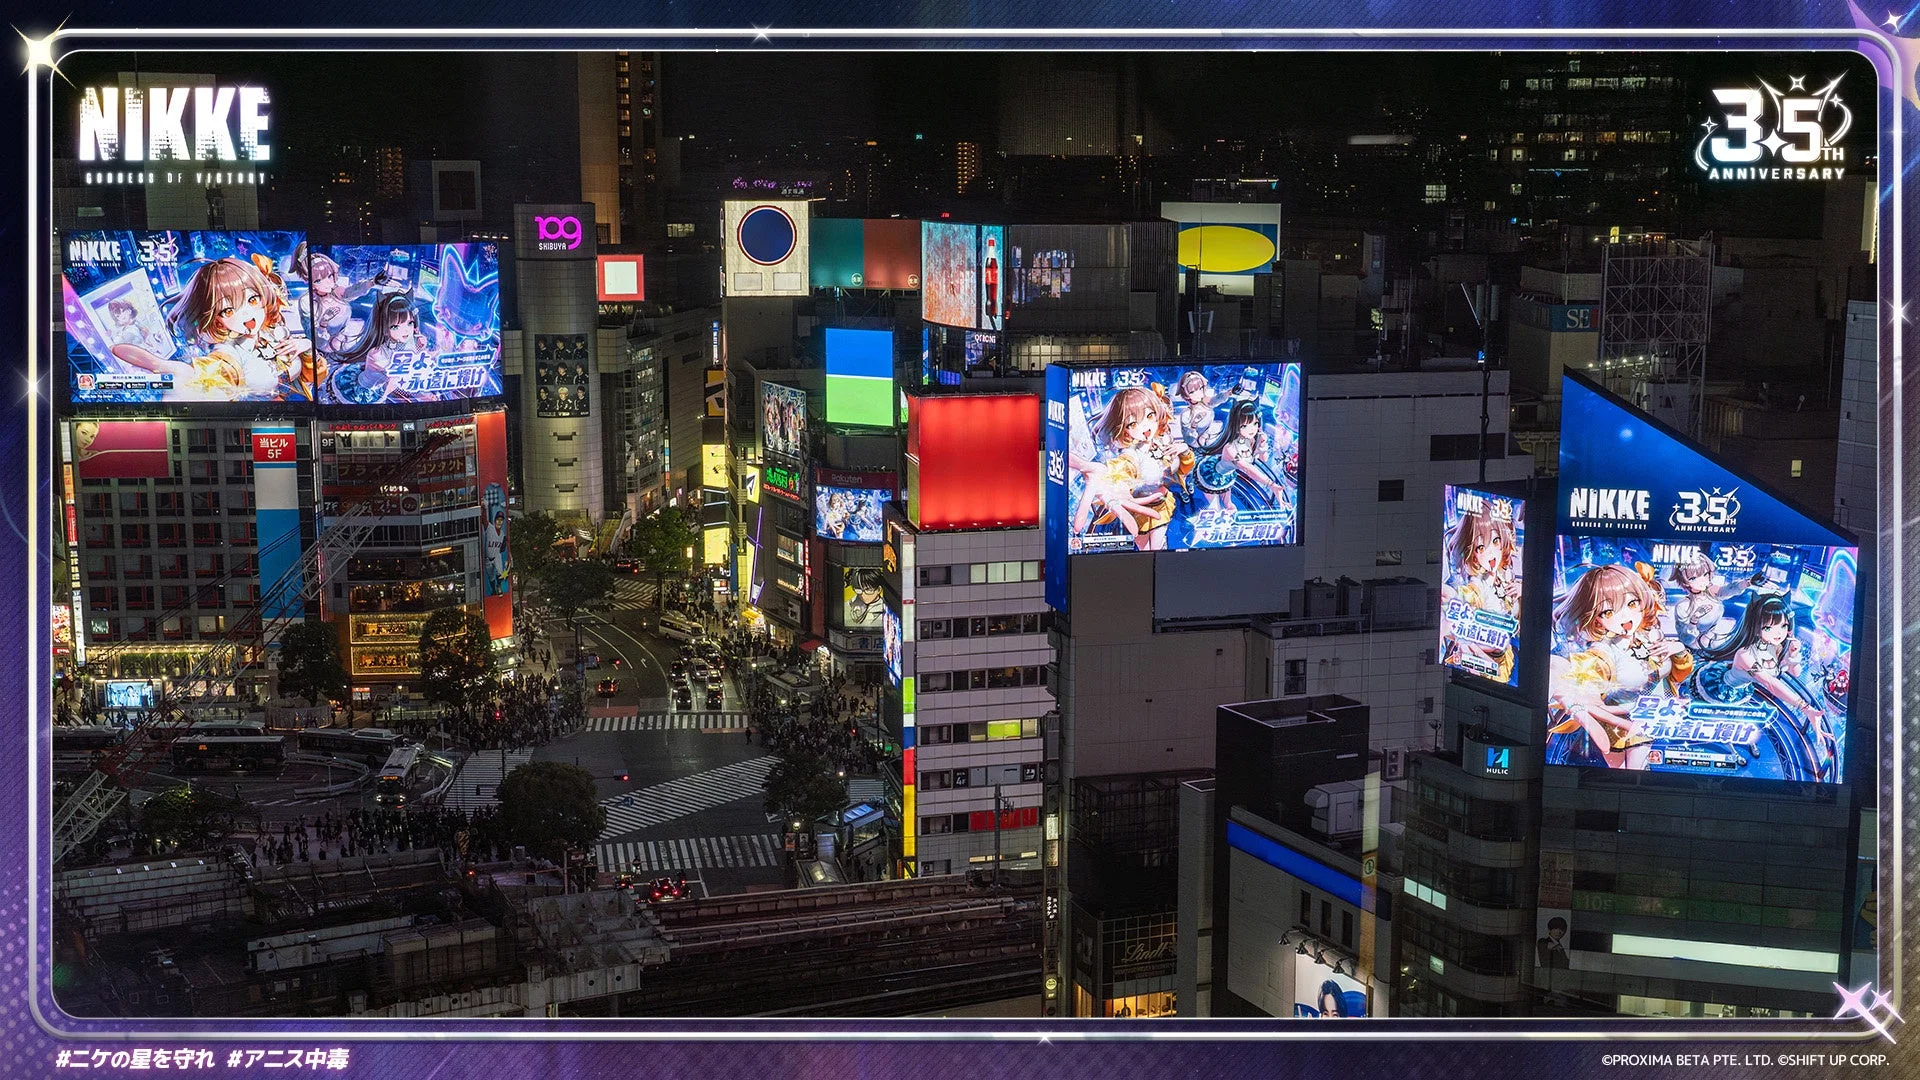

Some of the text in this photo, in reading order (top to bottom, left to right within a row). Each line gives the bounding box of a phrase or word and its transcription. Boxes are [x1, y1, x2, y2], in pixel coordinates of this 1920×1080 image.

[534, 216, 582, 250] 109
[69, 241, 121, 261] NIKKE
[539, 242, 567, 250] SHIBUYA
[406, 367, 485, 391] 永遠に輝け
[1072, 371, 1107, 387] NIKKE
[1048, 399, 1065, 424] NIKKE
[260, 437, 289, 448] 当ビル
[322, 438, 334, 447] 9F
[267, 448, 282, 459] 5F
[832, 473, 863, 484] Rakuten
[1457, 492, 1483, 514] NIKKE
[1570, 487, 1650, 521] NIKKE
[1209, 523, 1281, 540] 永遠に輝け
[1674, 525, 1737, 533] ANNIVERSARY
[1652, 544, 1700, 564] NIKKE
[1456, 621, 1508, 648] 永遠に輝け
[1650, 719, 1756, 744] 永遠に輝け
[1121, 943, 1169, 961] Lindt
